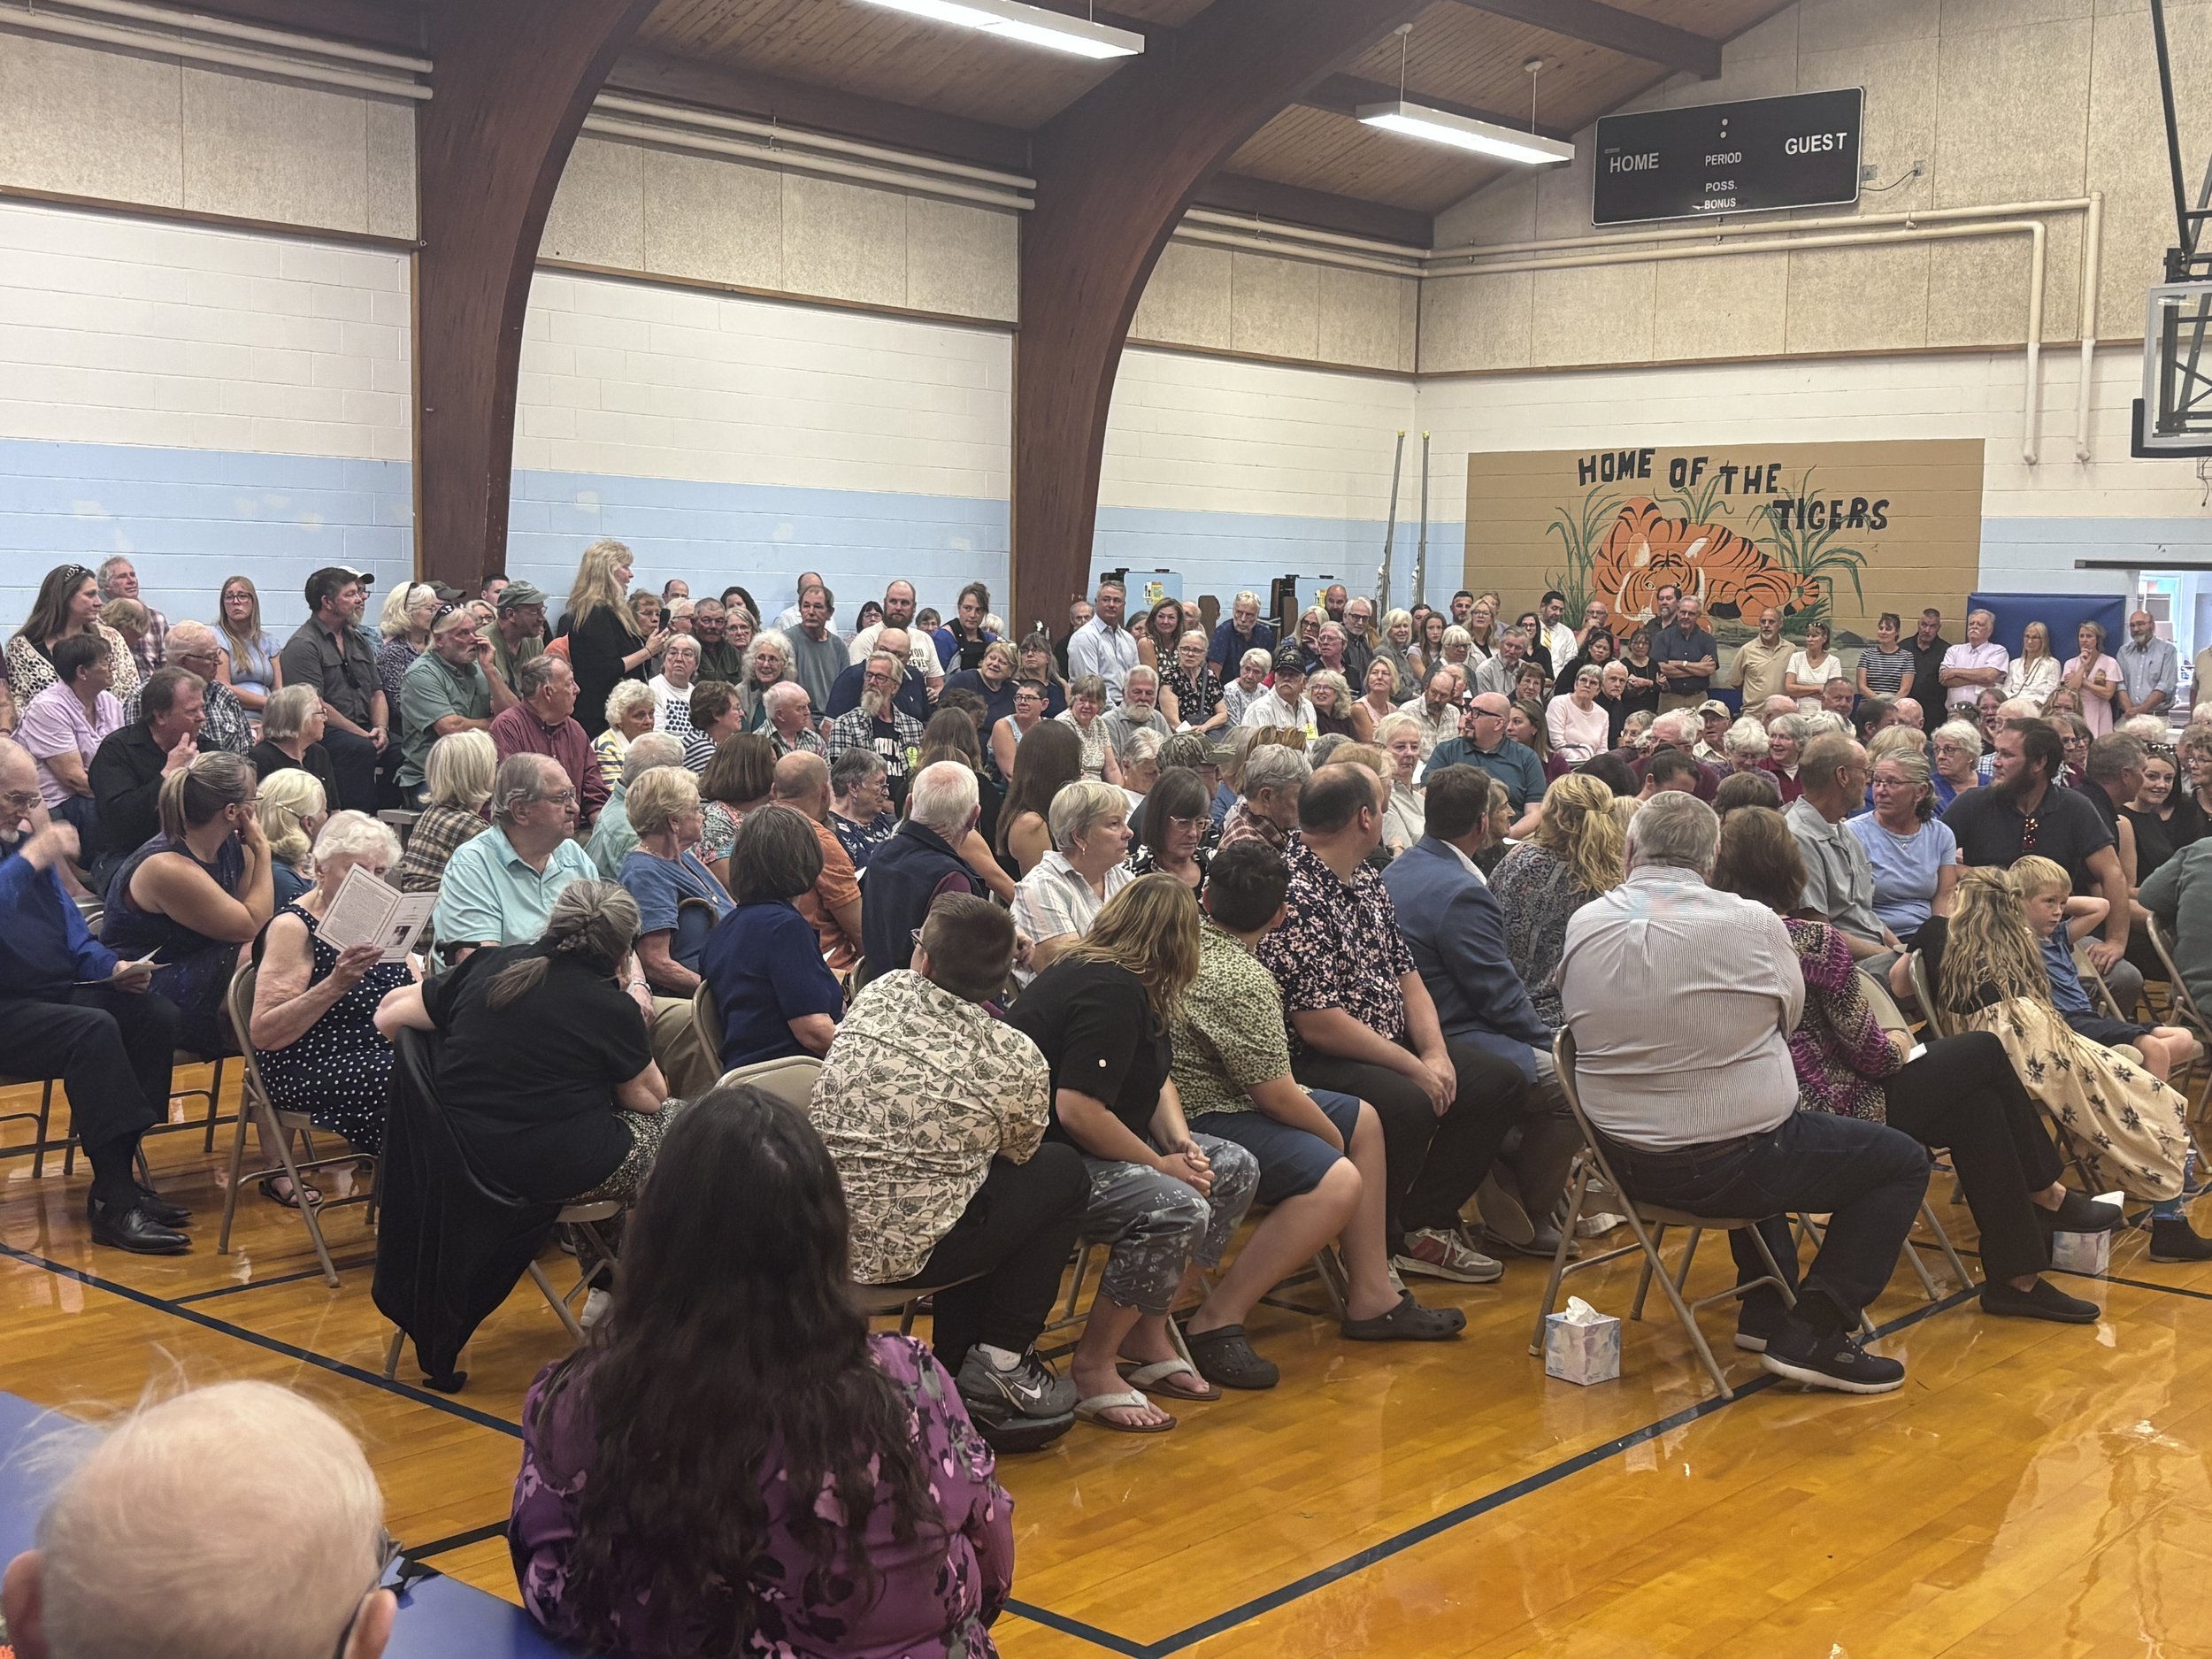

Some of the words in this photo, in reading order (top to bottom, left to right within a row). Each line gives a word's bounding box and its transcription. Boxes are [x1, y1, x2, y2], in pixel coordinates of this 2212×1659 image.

[1785, 132, 1848, 156] GUEST
[1609, 152, 1660, 173] HOME
[1705, 151, 1742, 166] PERIOD
[1705, 180, 1738, 192] POSS.
[1704, 197, 1737, 210] BONUS
[1578, 449, 1655, 486] HOME
[1669, 457, 1709, 488] OF
[1719, 463, 1781, 495] THE
[1772, 497, 1889, 531] TIGERS
